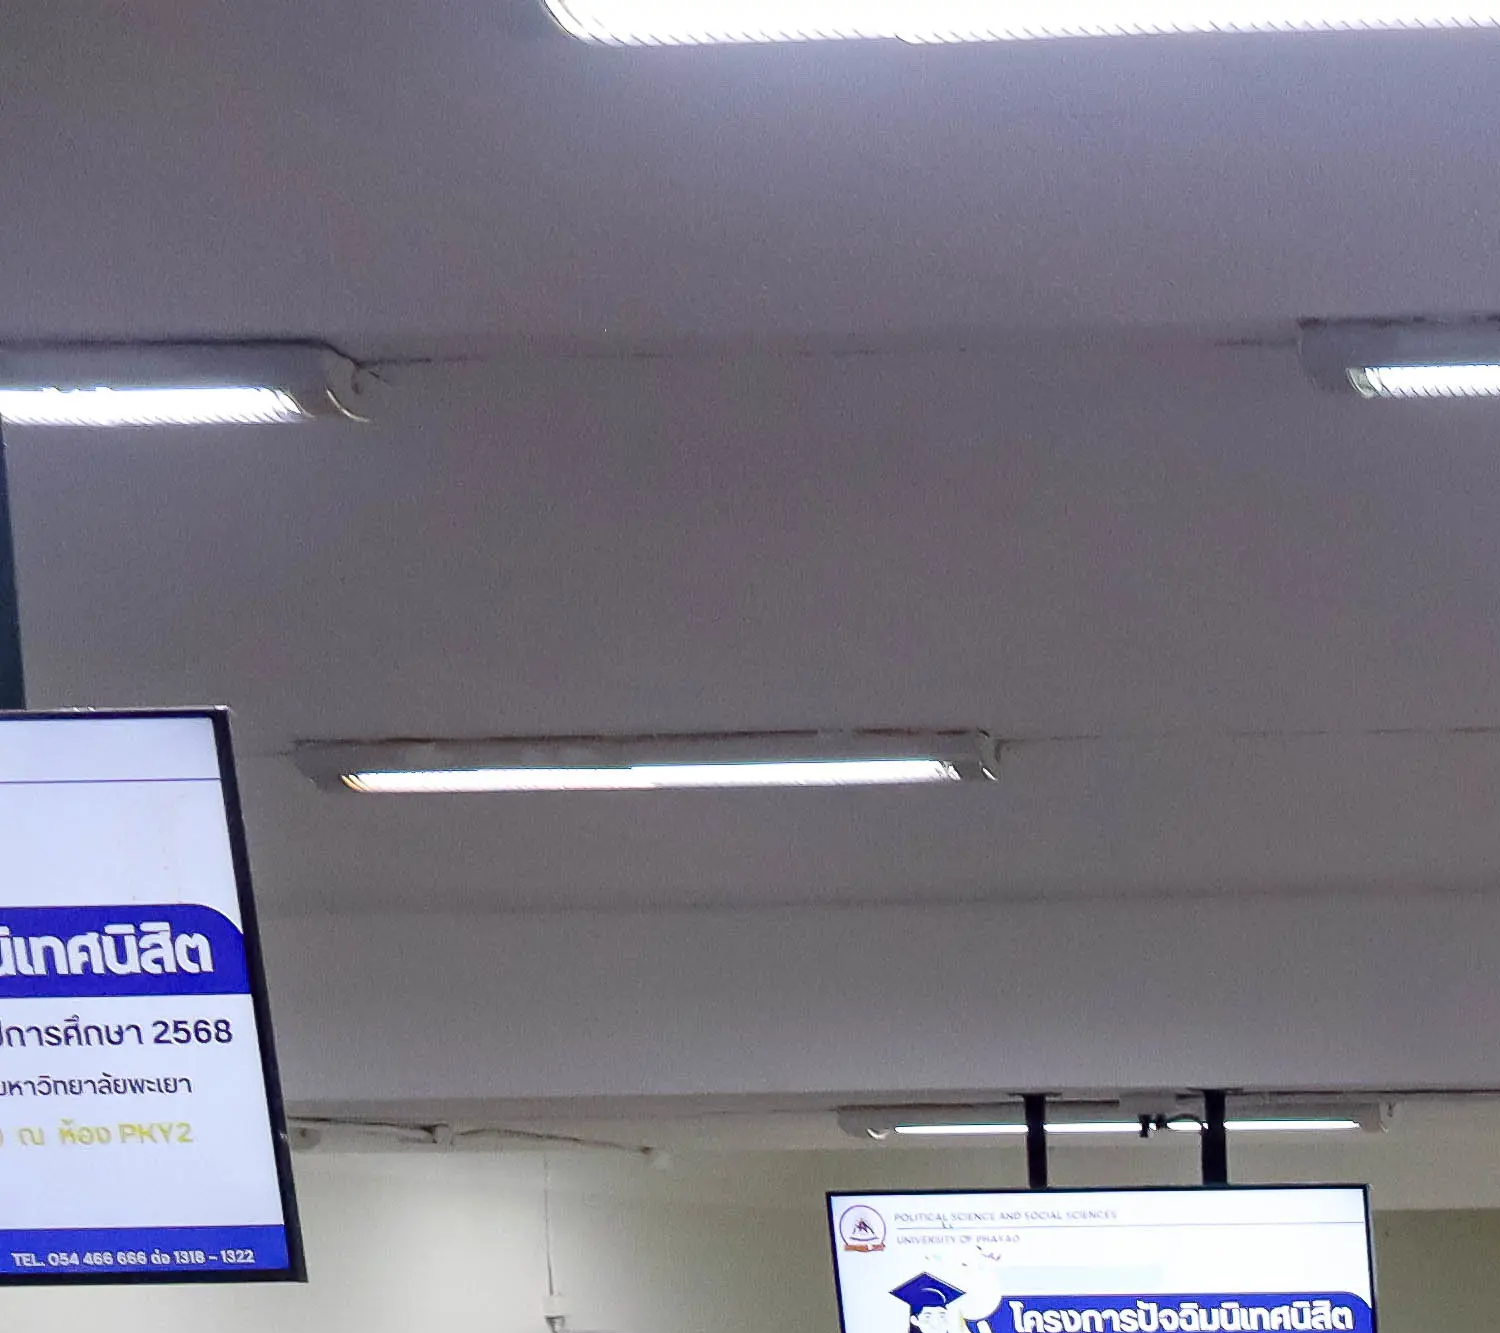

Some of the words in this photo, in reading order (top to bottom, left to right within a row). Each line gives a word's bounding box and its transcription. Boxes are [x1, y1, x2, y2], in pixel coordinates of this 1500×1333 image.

[0, 1014, 144, 1047] การศึกษา
[152, 1019, 233, 1045] 2568
[60, 1118, 112, 1146] ห้อง
[11, 1252, 45, 1267] TEL.
[48, 1252, 79, 1266] 054
[220, 1250, 255, 1264] 1322
[1009, 1300, 1354, 1333] โครงการปัจฉิมนิเทศนิสิต
